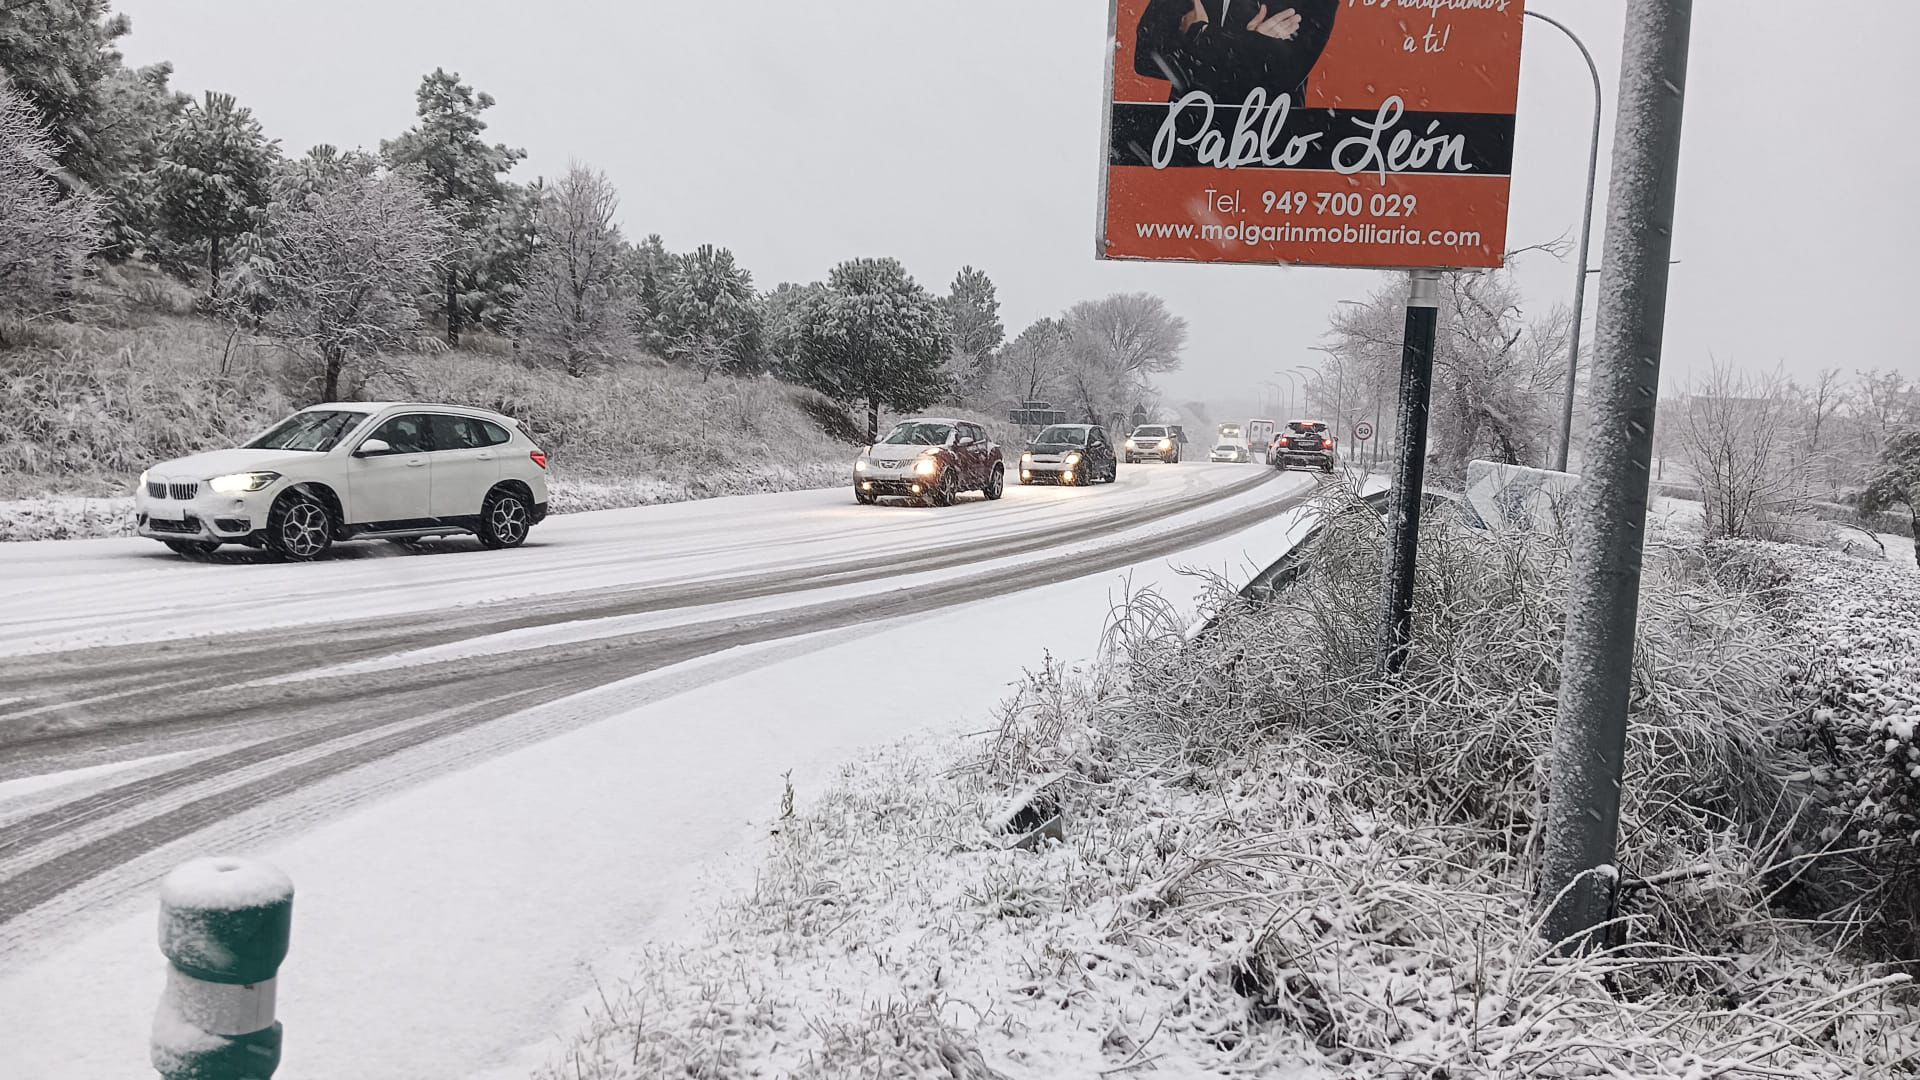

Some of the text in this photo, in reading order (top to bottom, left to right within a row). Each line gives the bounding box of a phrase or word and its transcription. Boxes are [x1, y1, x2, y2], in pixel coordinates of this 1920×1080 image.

[1397, 0, 1511, 18] pamos
[1403, 23, 1451, 53] a ti!
[1152, 86, 1473, 186] Pablo León
[1205, 189, 1418, 218] Tel. 949 700 029
[1136, 220, 1481, 247] www.molgarinmobiliaria.com
